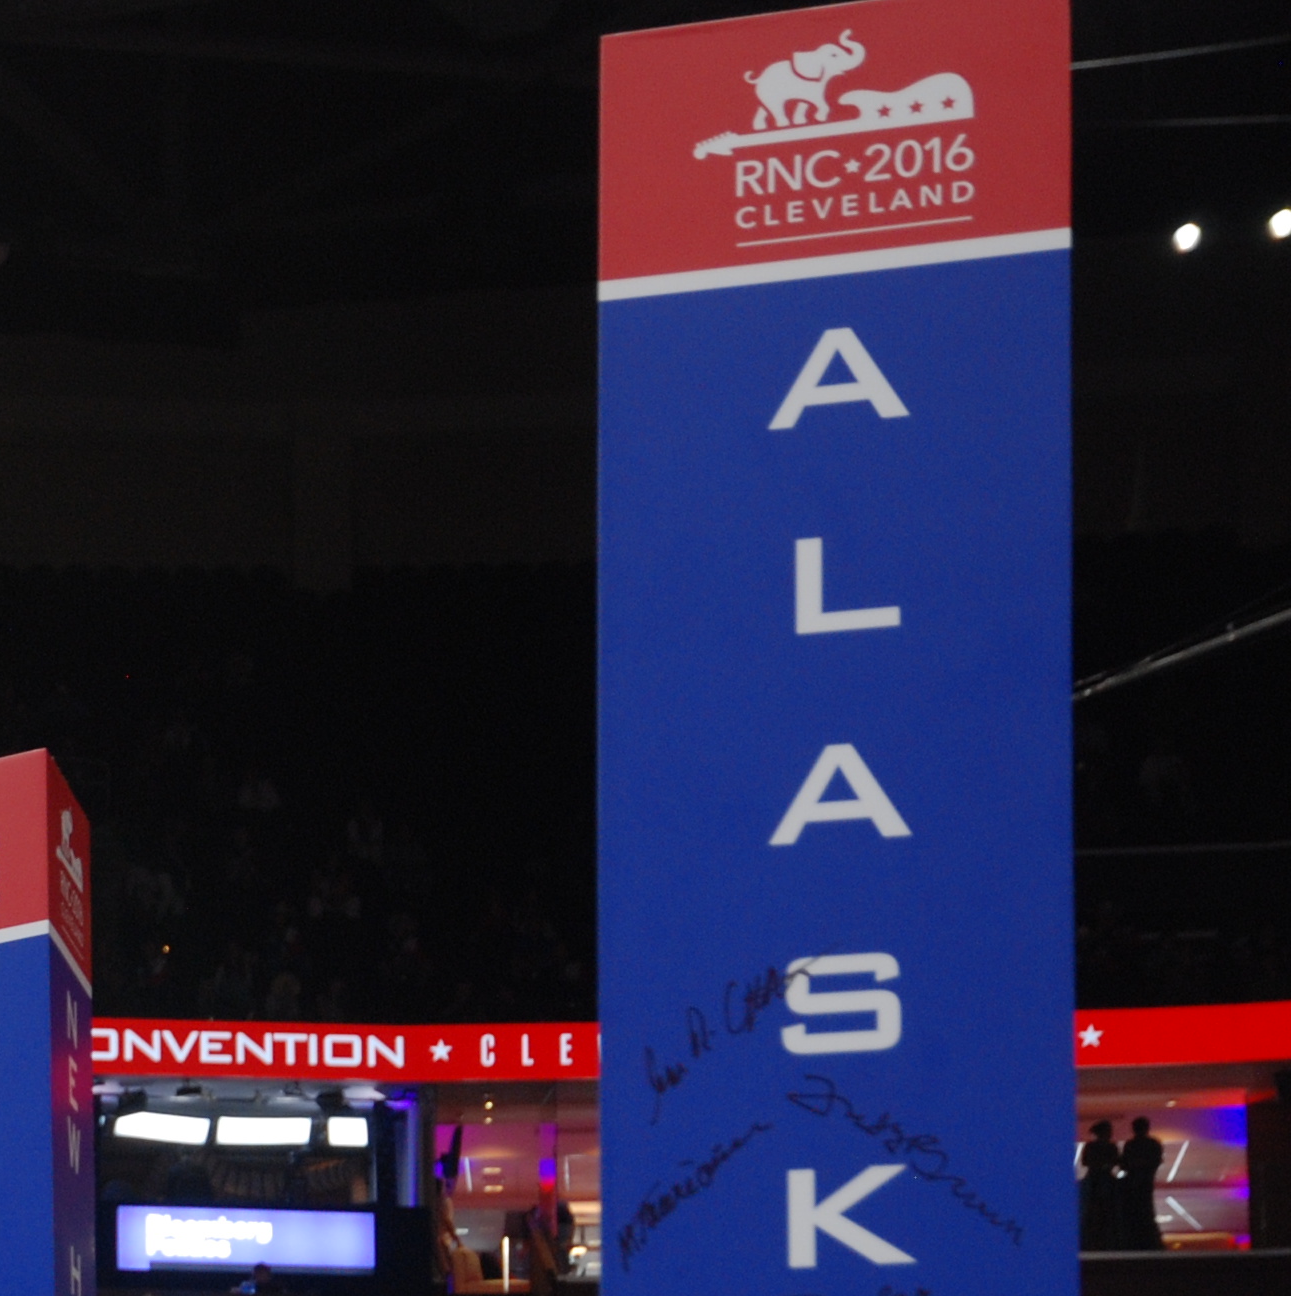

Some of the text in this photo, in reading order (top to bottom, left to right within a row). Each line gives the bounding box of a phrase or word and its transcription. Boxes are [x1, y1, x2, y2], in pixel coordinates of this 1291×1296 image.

[735, 134, 975, 197] RNC 2016
[735, 179, 976, 229] CLEVELAND
[479, 1031, 600, 1067] CLE
